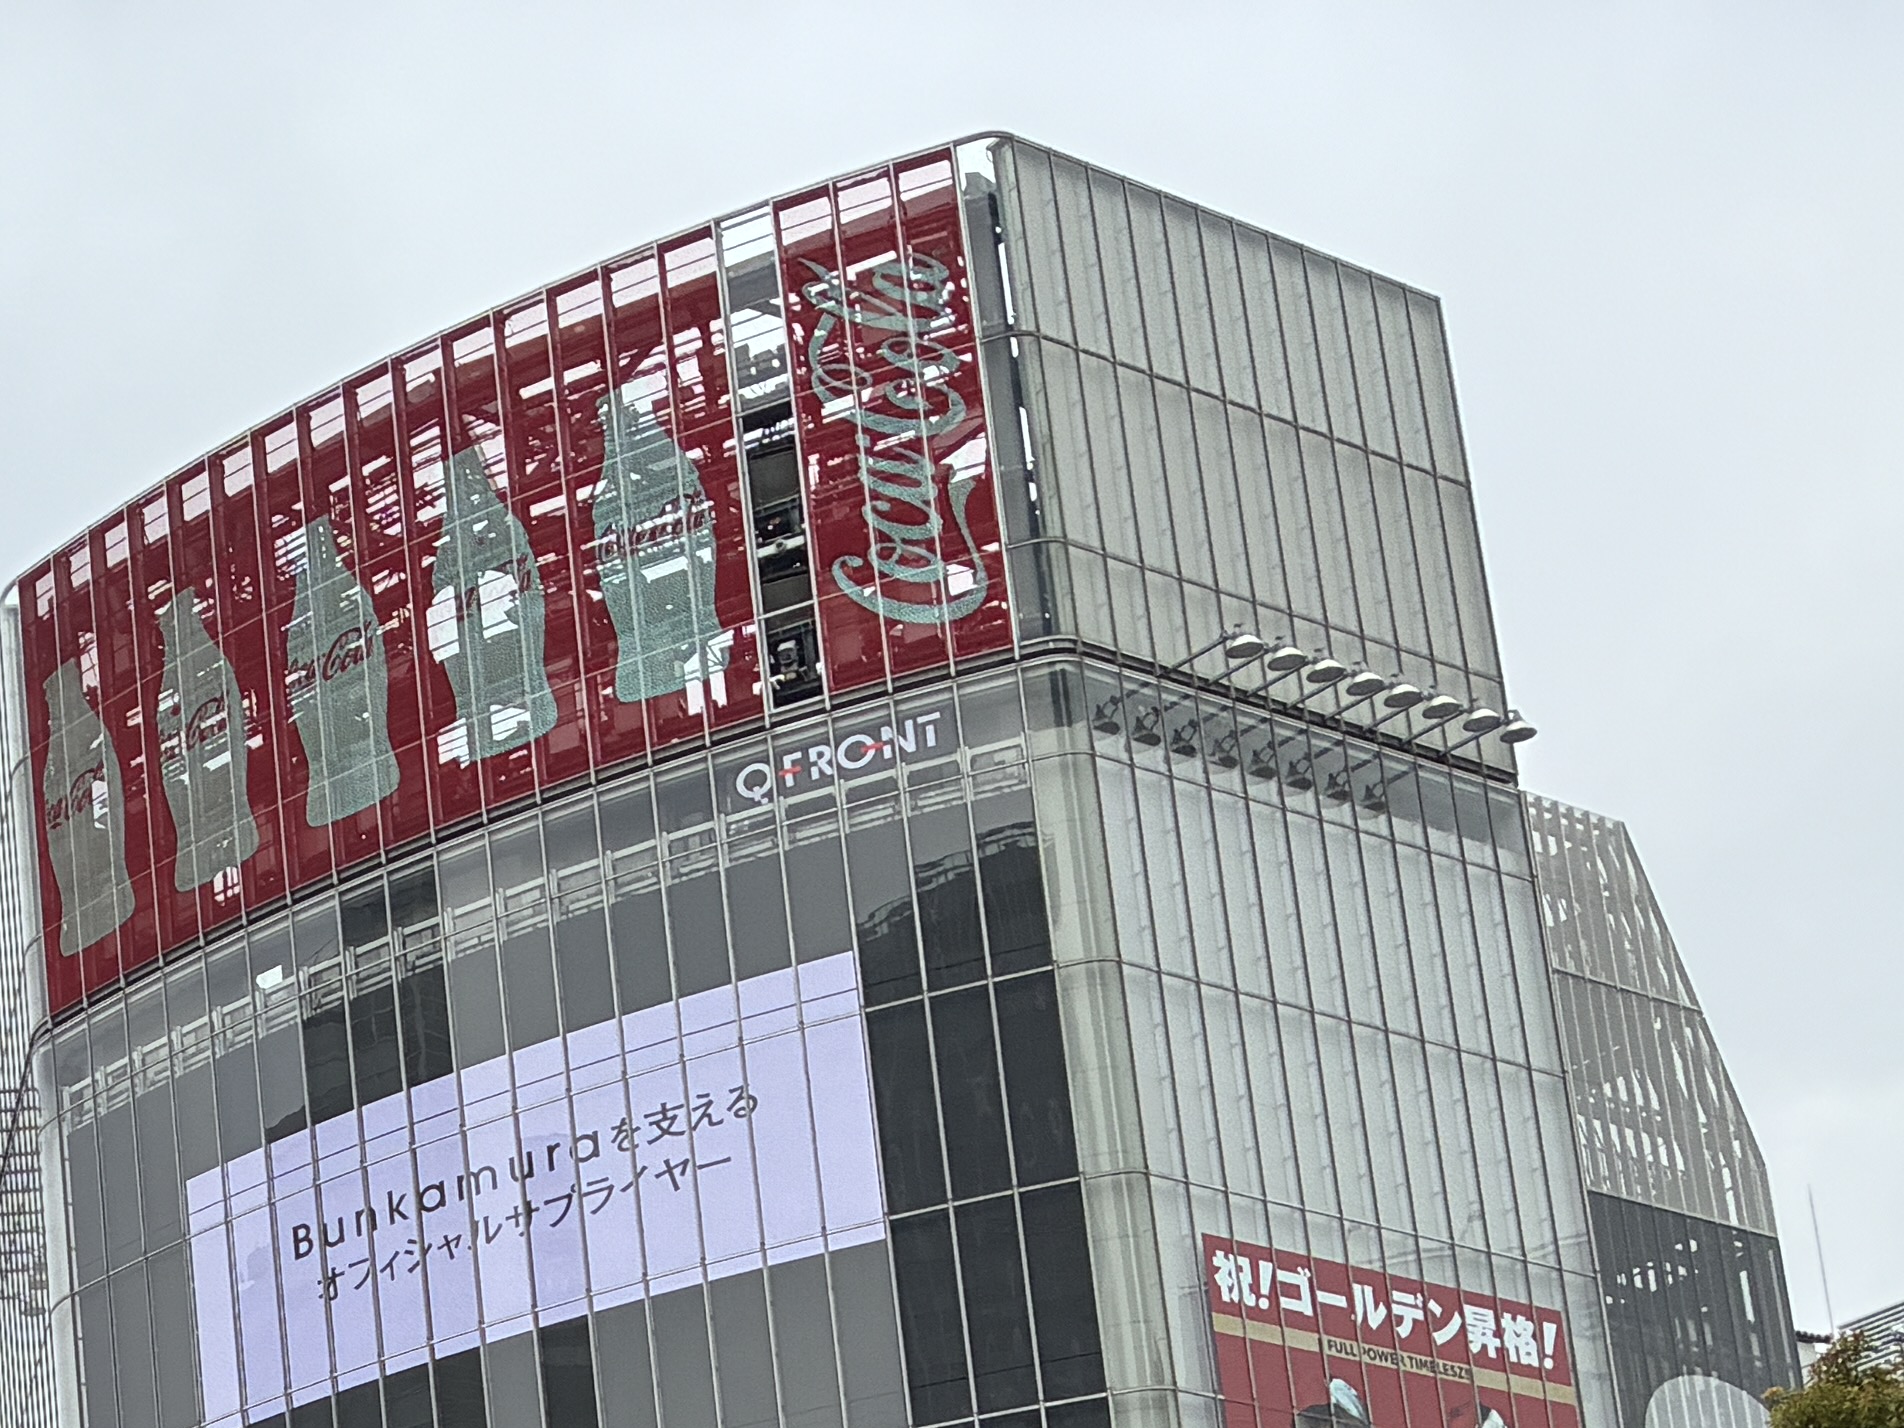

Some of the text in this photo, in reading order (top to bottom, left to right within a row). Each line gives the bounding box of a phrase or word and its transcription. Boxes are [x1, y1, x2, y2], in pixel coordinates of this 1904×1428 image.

[735, 710, 942, 803] QFRONT
[291, 1085, 759, 1261] Bunkamuraを支える
